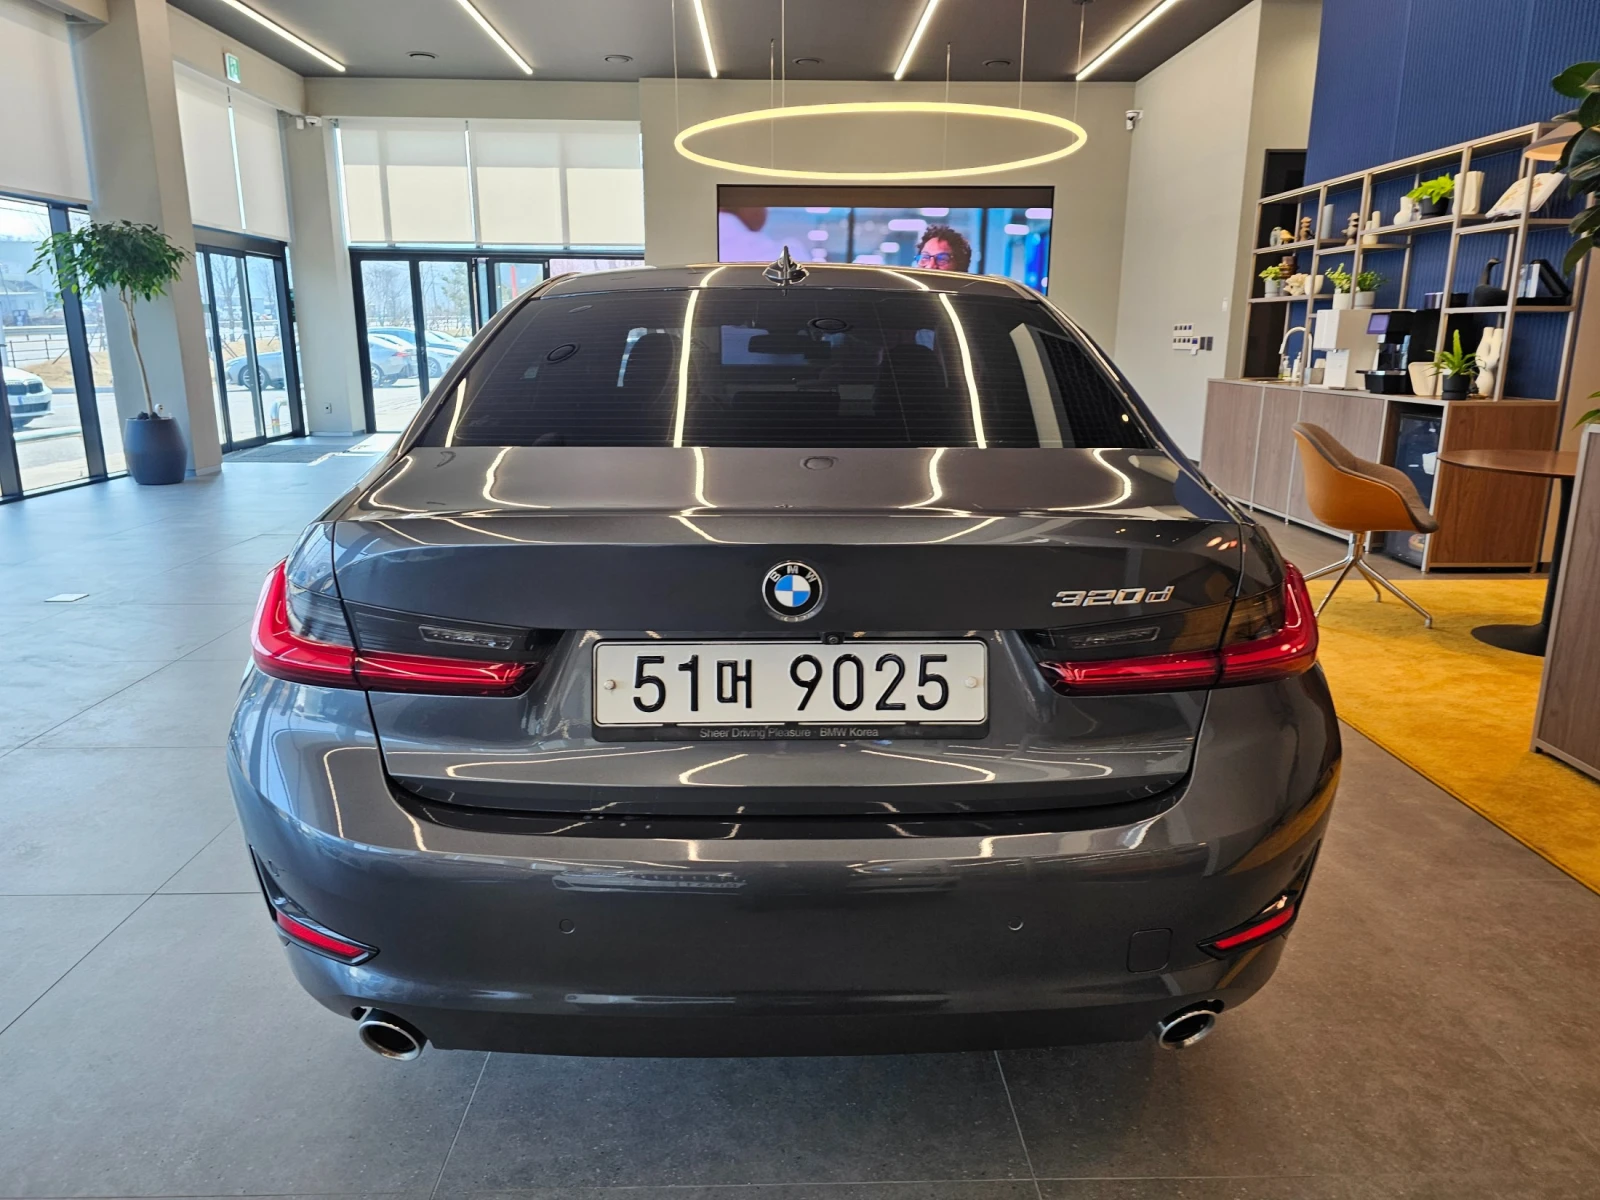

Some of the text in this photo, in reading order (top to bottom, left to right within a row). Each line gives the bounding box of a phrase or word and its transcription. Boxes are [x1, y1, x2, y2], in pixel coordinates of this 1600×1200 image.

[769, 565, 817, 583] BMW
[1051, 585, 1175, 608] 320d
[633, 653, 950, 713] 51머 9025
[699, 728, 879, 740] Sheer Driving Pleasure BMW Korea
